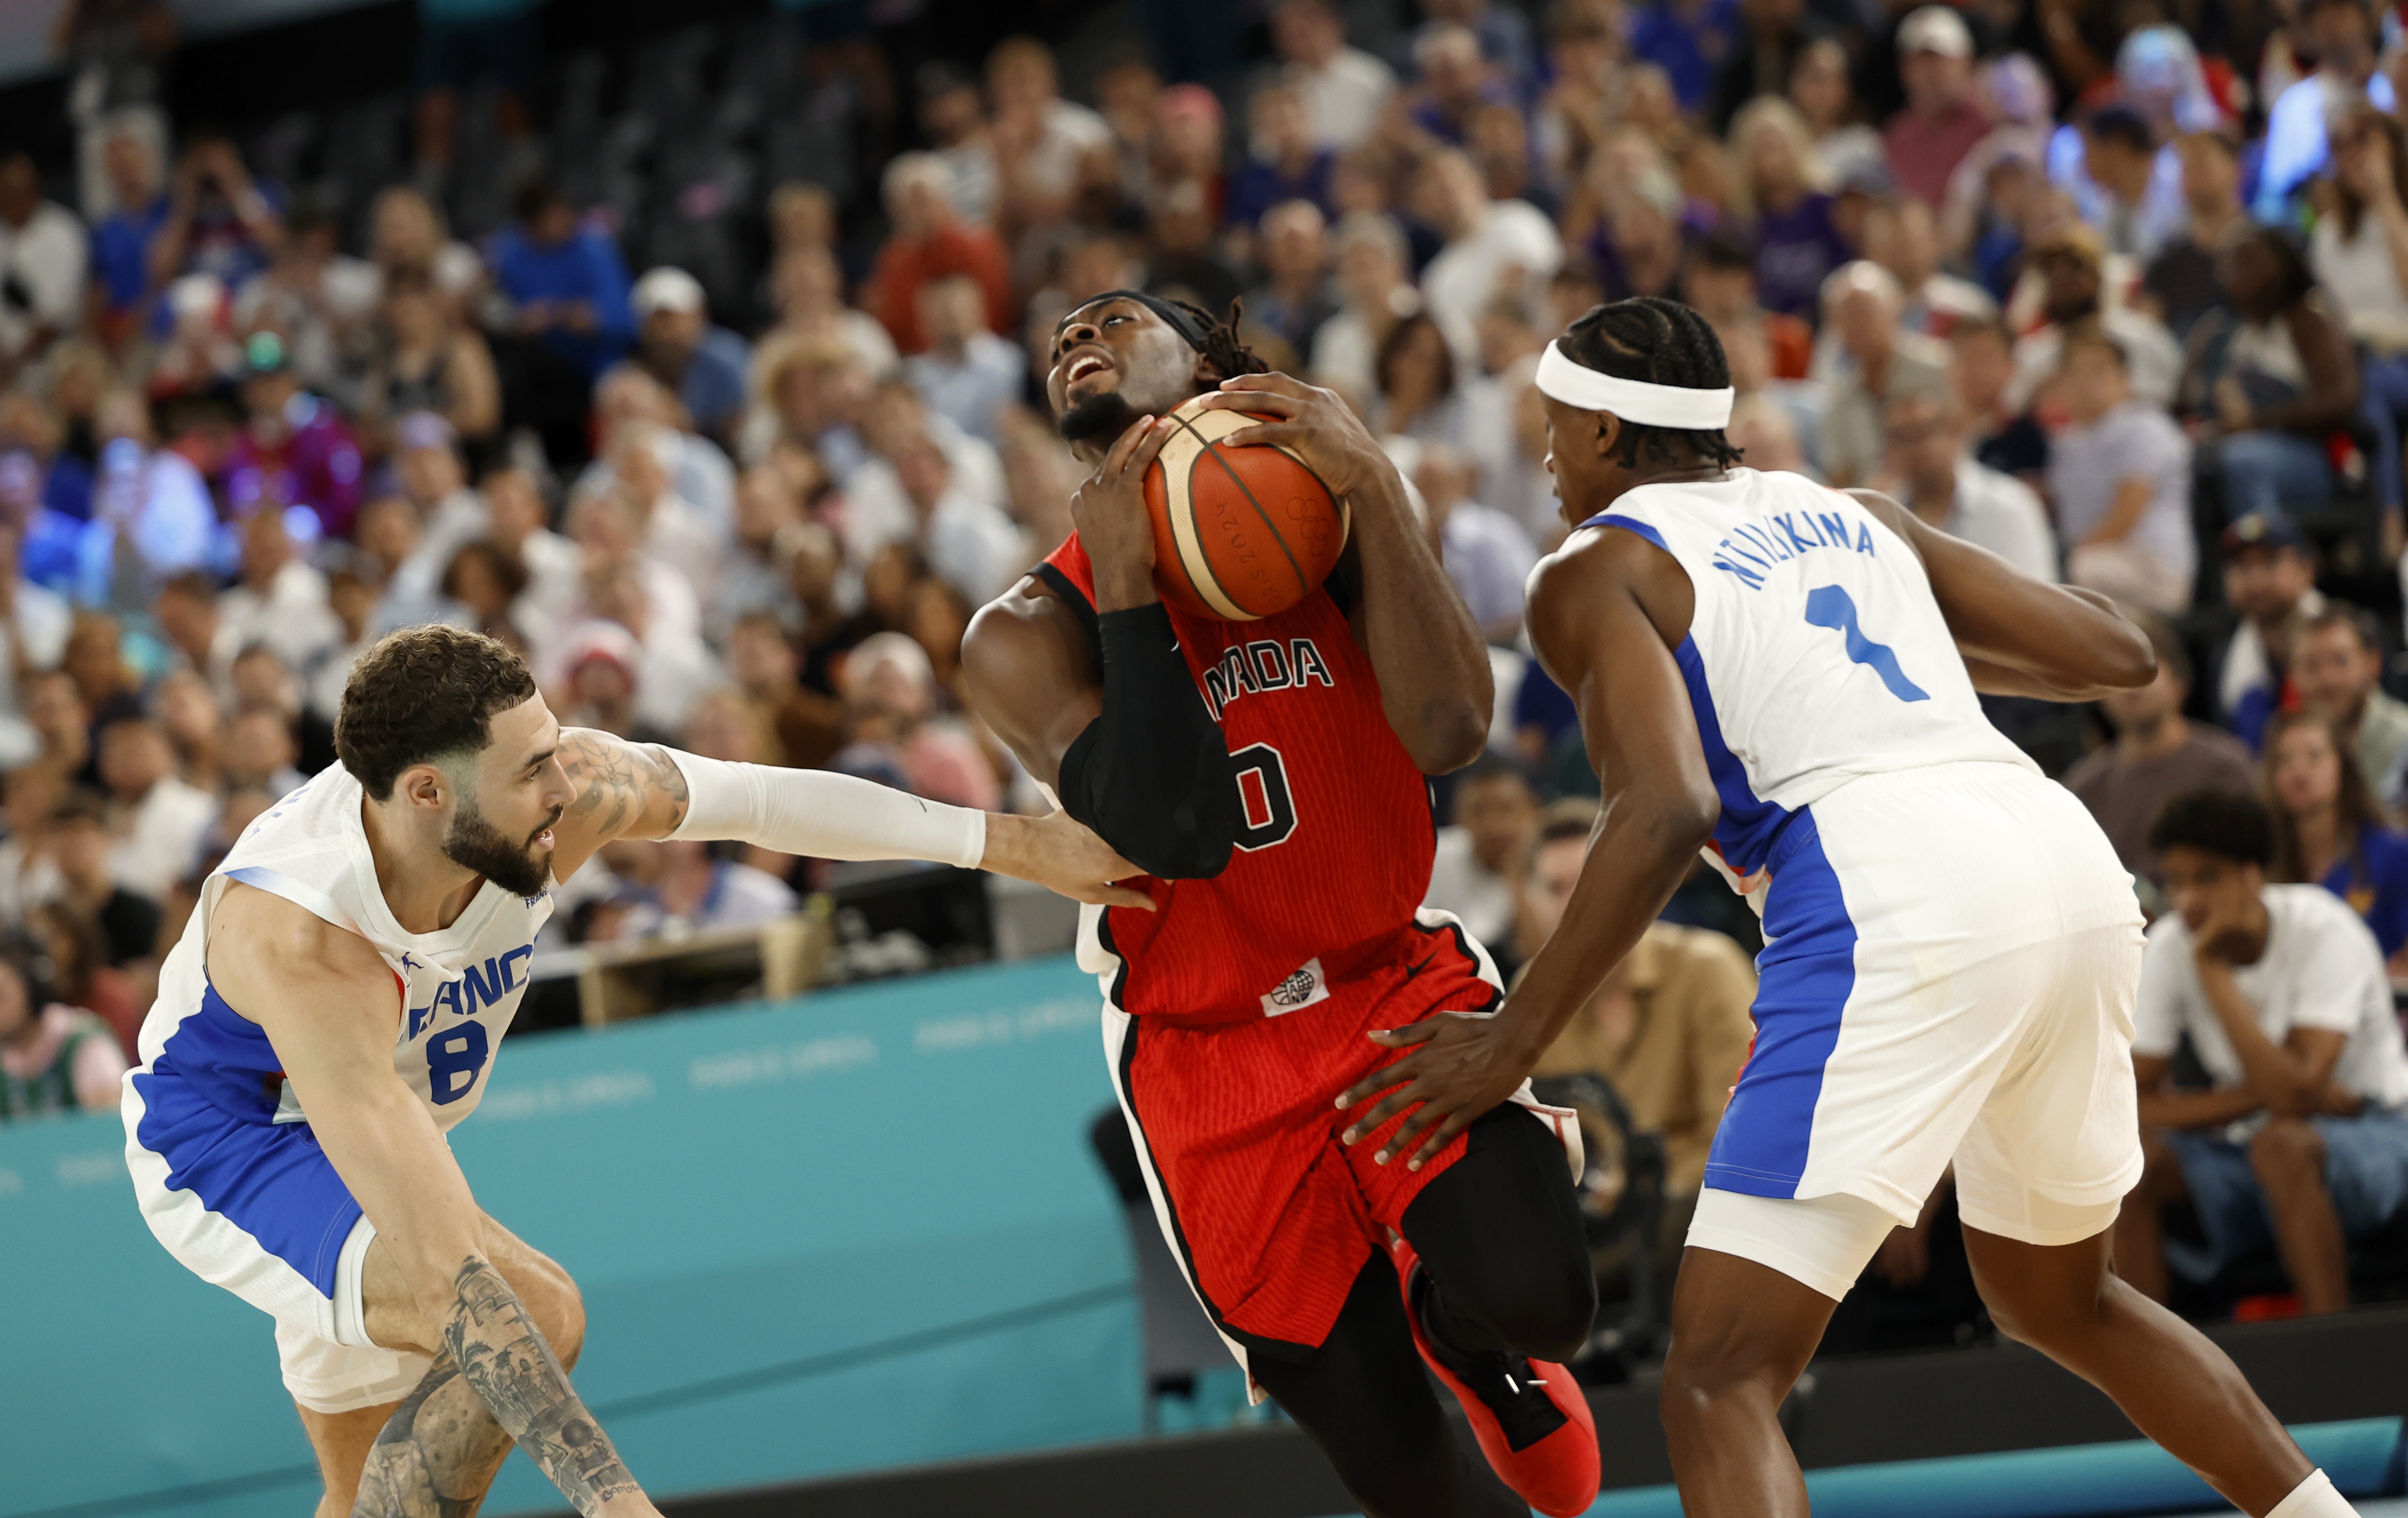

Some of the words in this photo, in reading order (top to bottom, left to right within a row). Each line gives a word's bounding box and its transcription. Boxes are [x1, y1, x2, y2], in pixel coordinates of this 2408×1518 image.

[1217, 501, 1257, 564] 2024
[1198, 638, 1335, 723] NADA
[1804, 584, 1931, 702] 1
[1229, 741, 1299, 853] 0
[426, 1020, 489, 1106] 8
